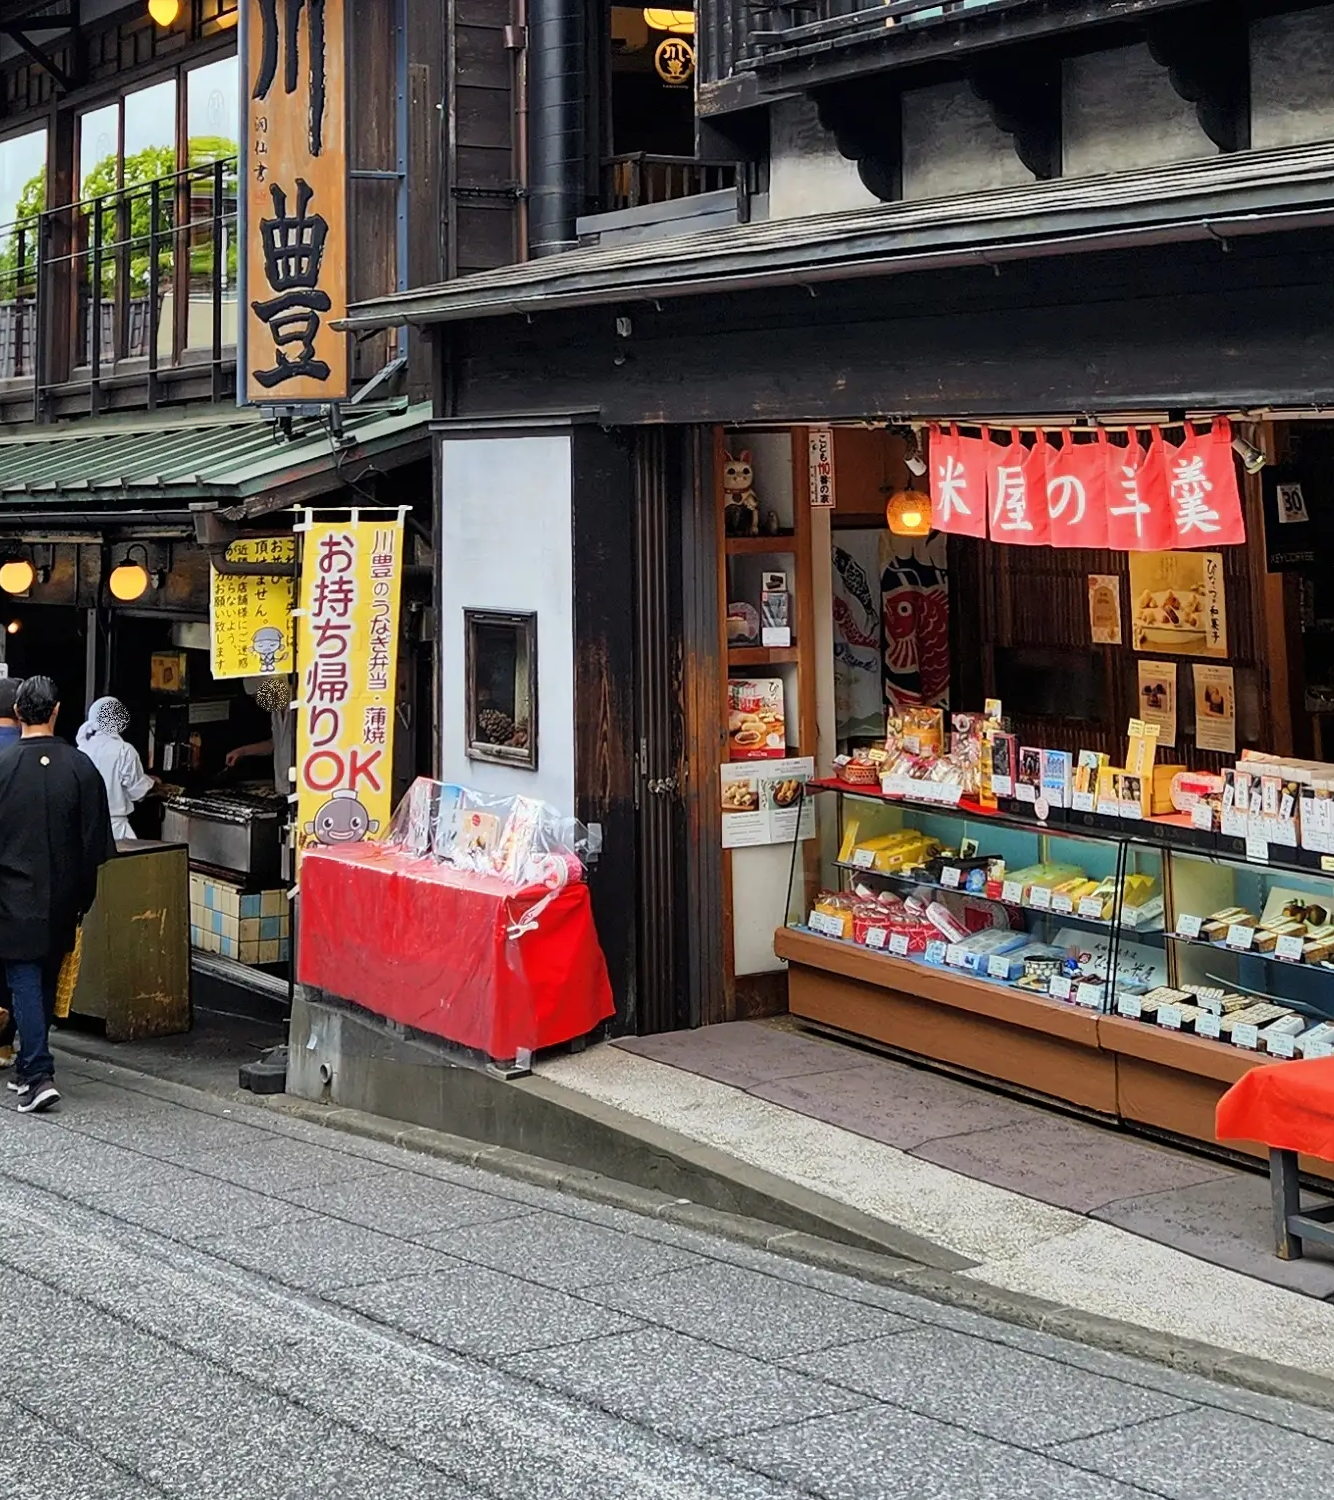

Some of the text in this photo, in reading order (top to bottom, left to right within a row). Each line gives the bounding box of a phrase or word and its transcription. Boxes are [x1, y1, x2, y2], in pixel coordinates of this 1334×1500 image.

[937, 455, 1221, 537] 米屋の羊羹
[306, 534, 355, 748] お持ち帰り
[363, 530, 394, 744] 川豊のうなぎ弁当・蒲焼
[303, 750, 382, 792] OK
